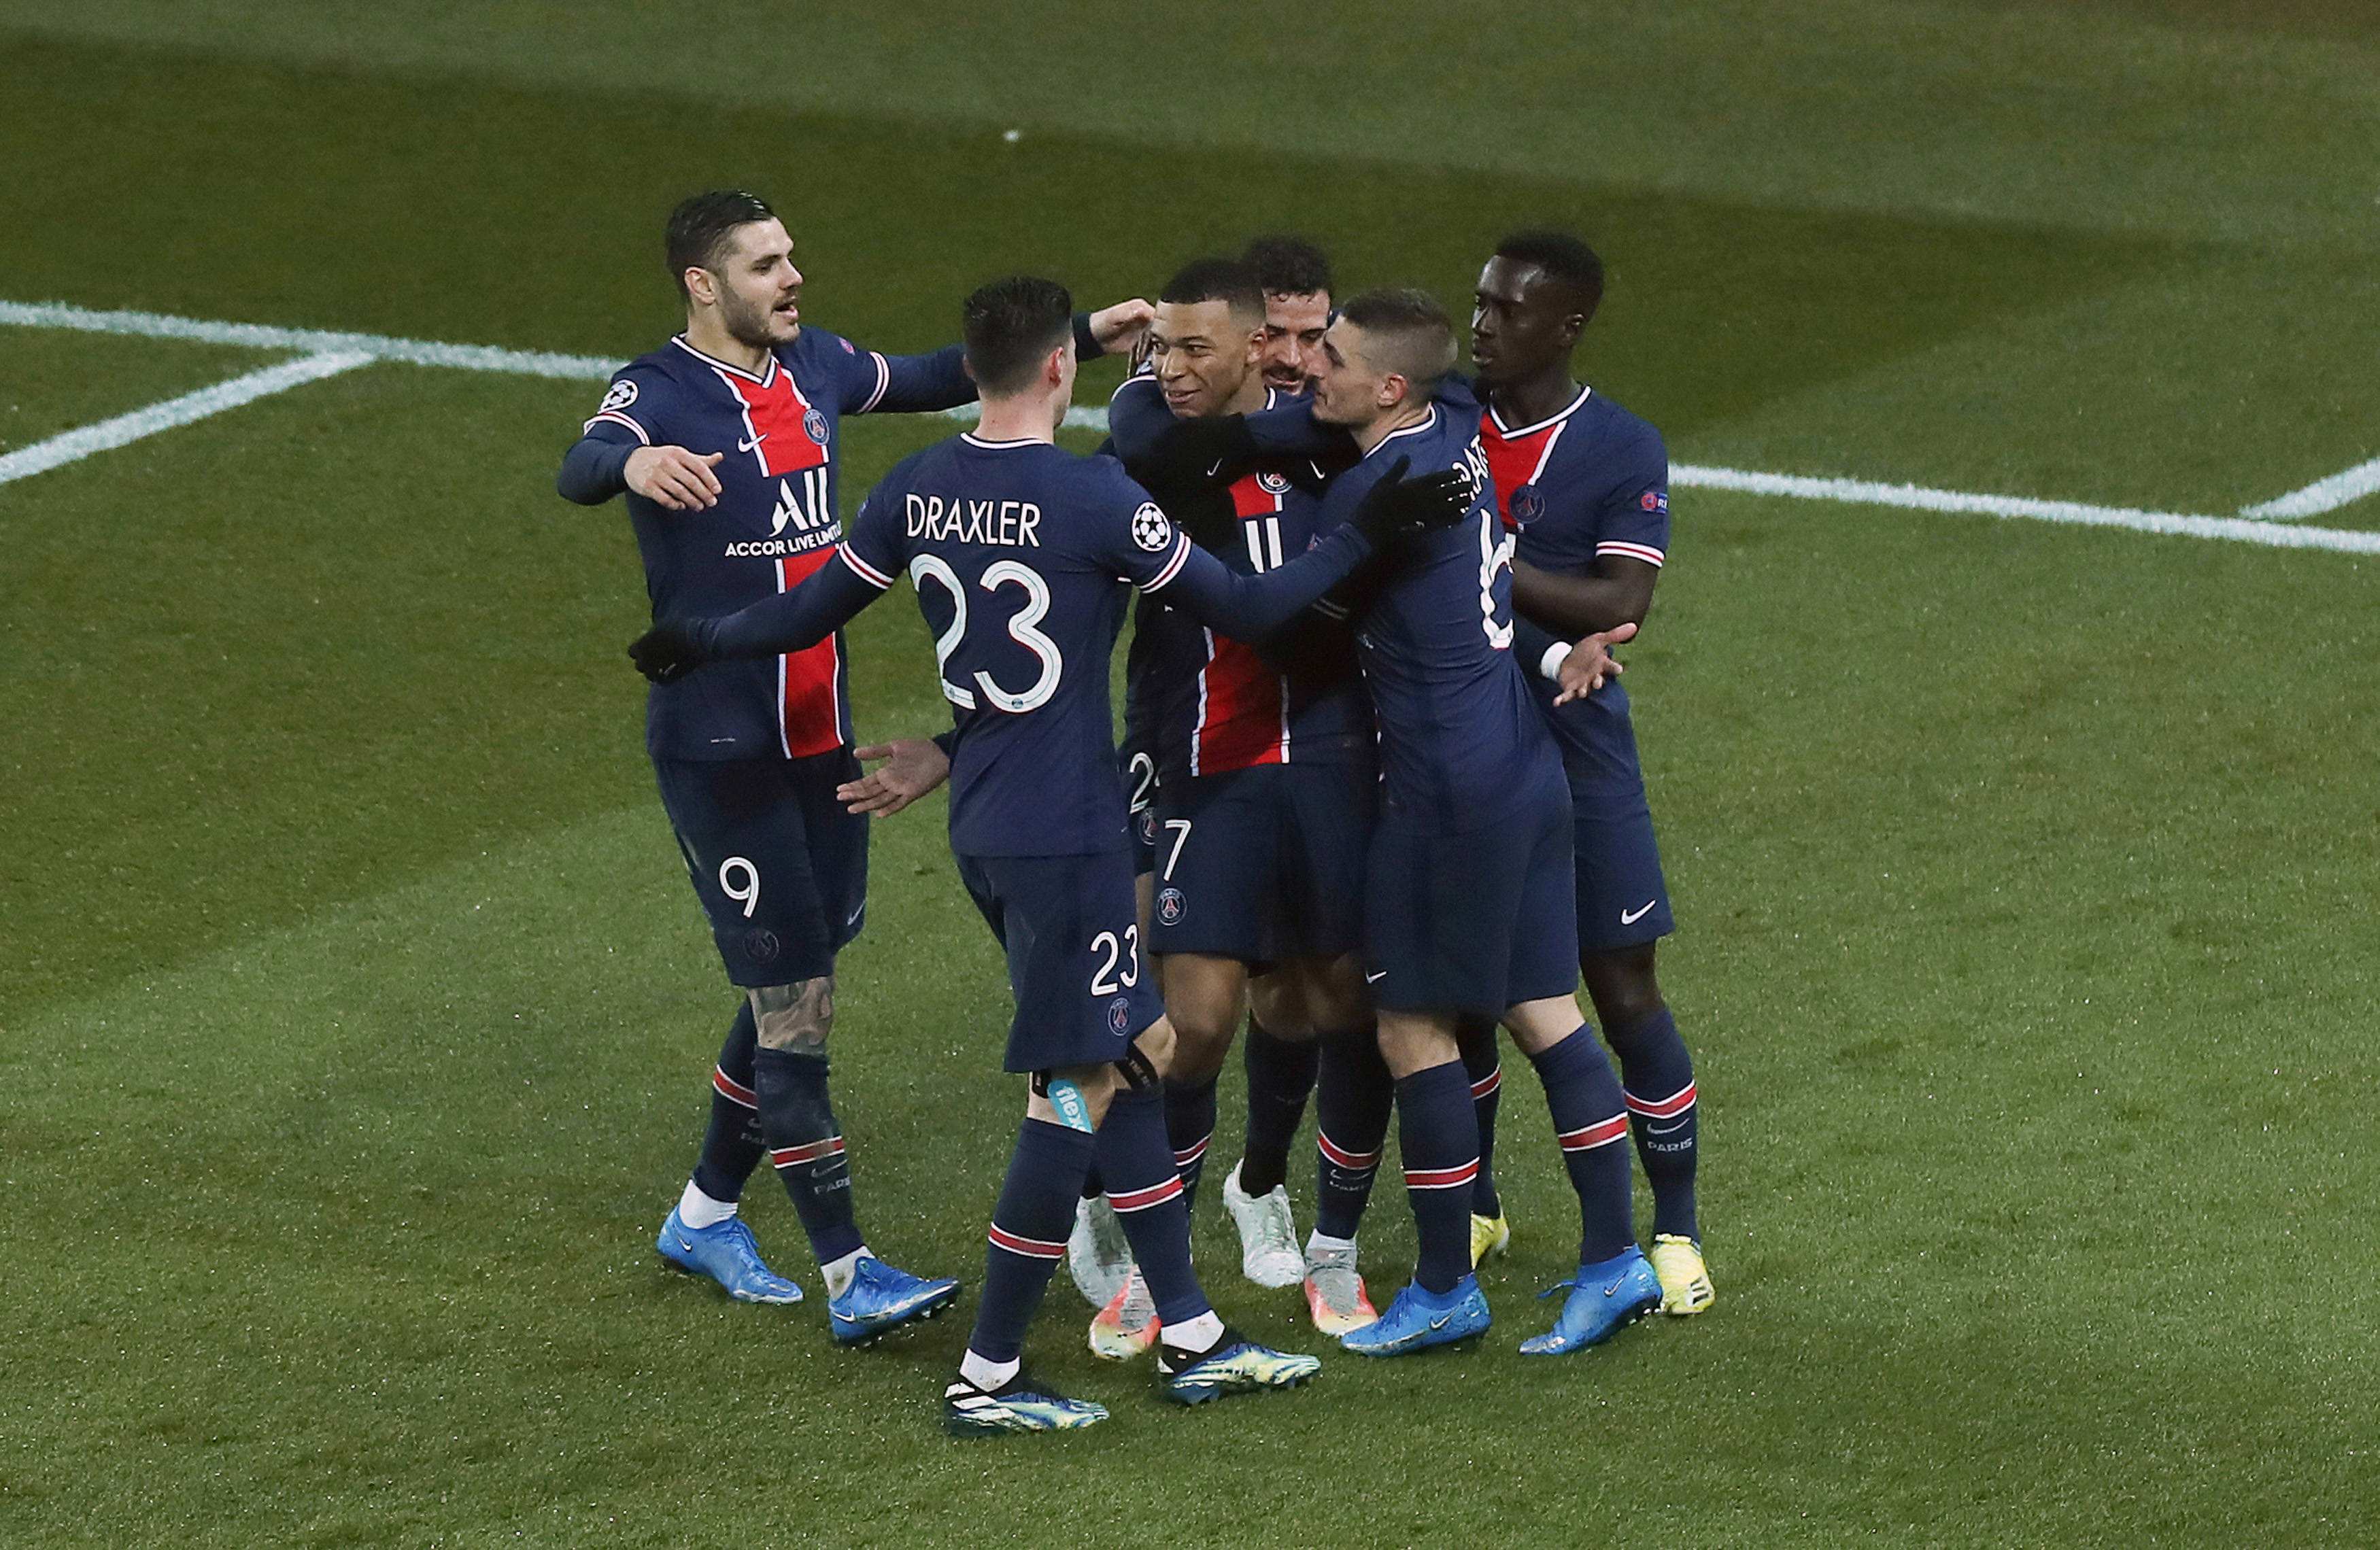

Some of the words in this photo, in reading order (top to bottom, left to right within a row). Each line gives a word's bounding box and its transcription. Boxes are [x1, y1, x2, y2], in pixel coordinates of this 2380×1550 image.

[725, 540, 787, 557] ACCOR
[787, 534, 817, 553] LIVE
[905, 494, 1041, 547] DRAXLER
[909, 553, 1063, 713] 23
[1129, 752, 1160, 814] 2
[1165, 820, 1191, 881] 7
[719, 857, 759, 917] 9
[1090, 924, 1138, 996] 23
[1648, 1137, 1693, 1152] PARIS
